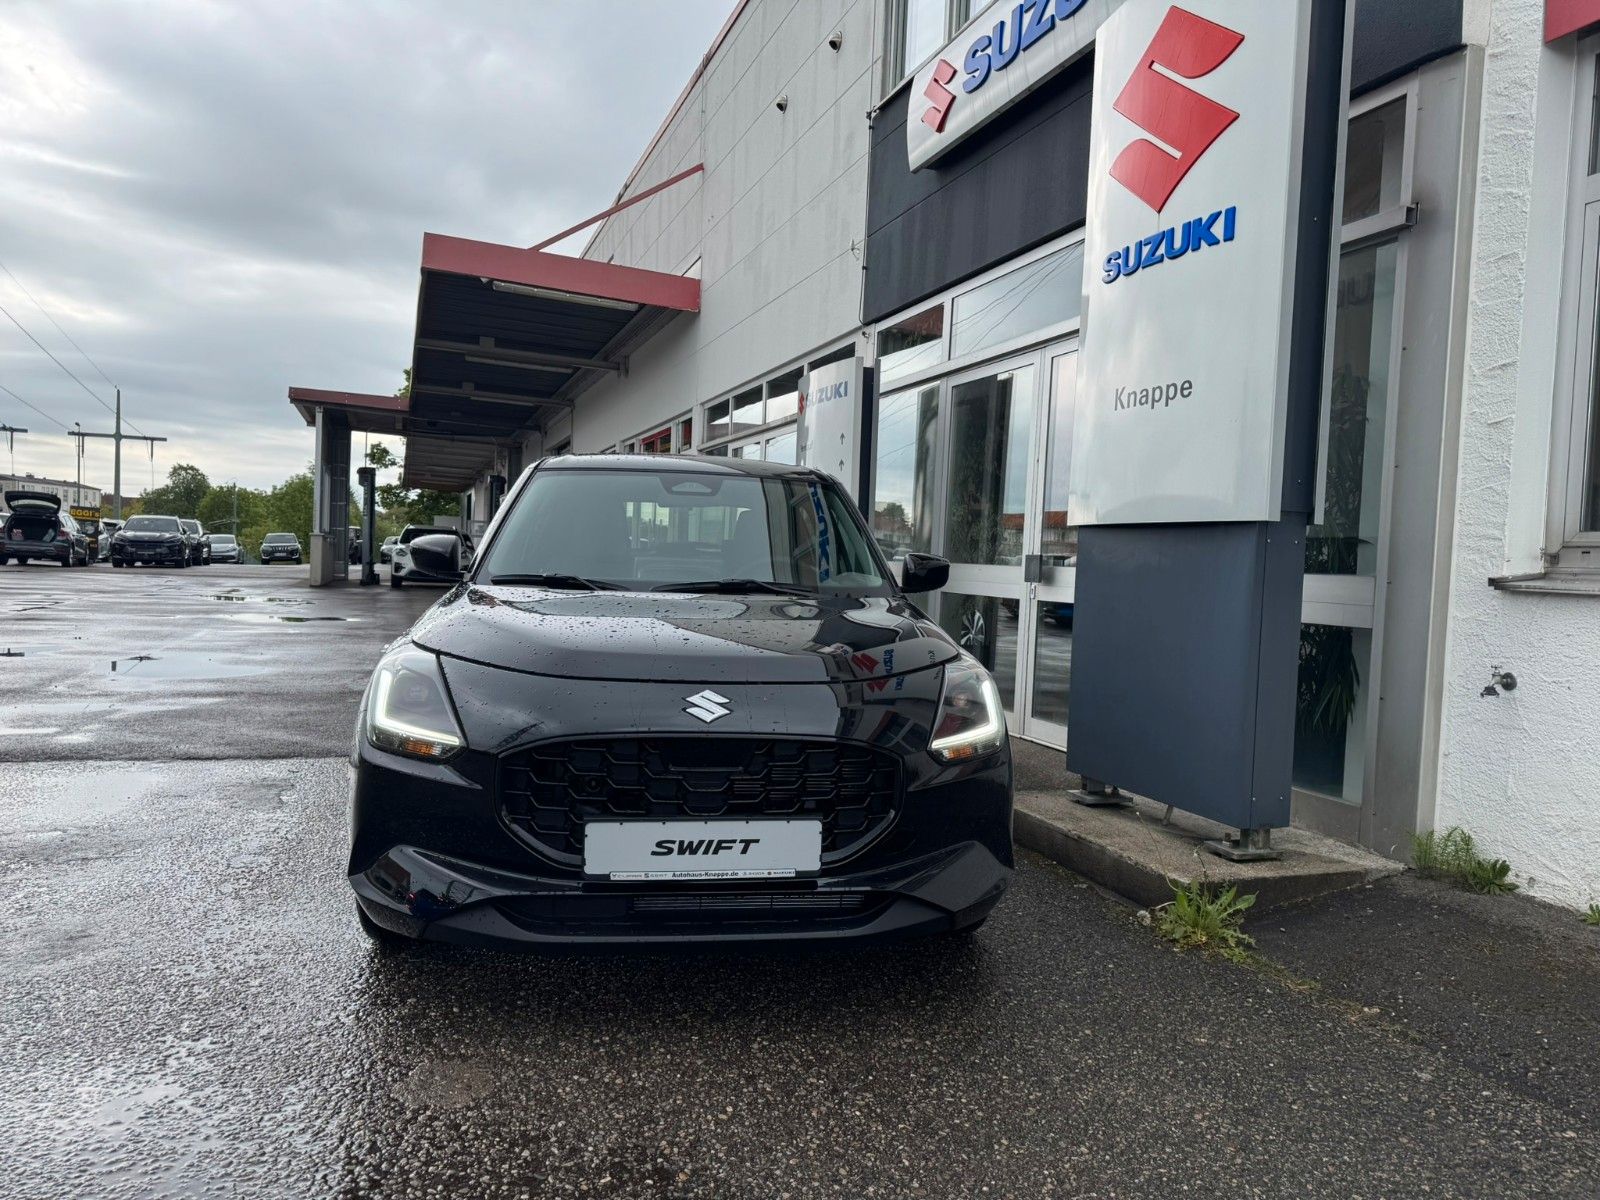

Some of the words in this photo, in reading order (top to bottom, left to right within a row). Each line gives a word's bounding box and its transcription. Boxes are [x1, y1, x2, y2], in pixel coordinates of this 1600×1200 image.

[1102, 205, 1237, 284] SUZUKI
[1114, 379, 1193, 411] Knappe
[650, 839, 760, 856] SWIFT
[671, 871, 739, 879] Autohaus-Knappe.de
